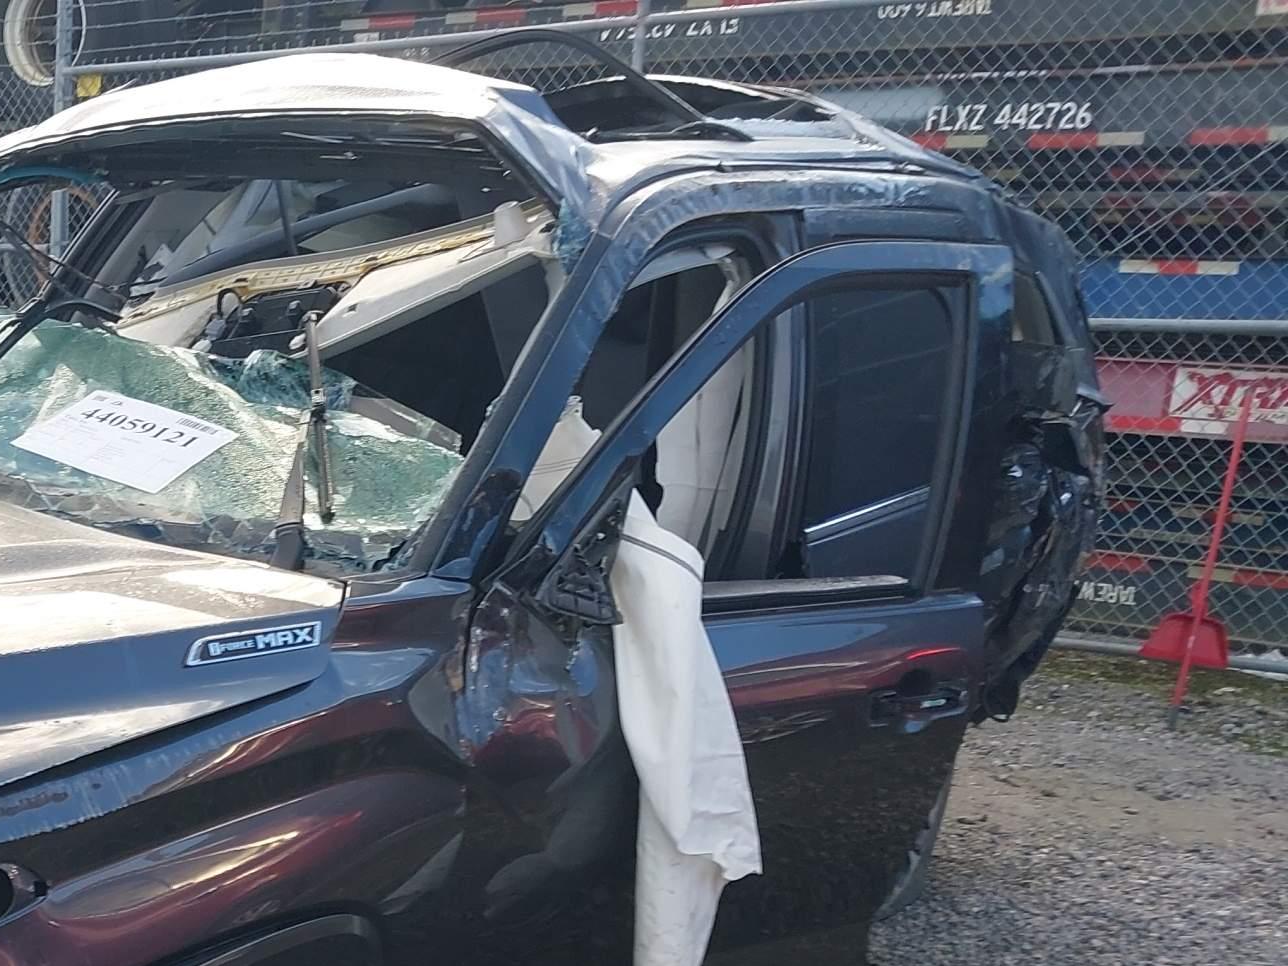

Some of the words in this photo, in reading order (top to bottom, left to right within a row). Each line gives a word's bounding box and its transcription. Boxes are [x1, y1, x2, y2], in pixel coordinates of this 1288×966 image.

[924, 103, 987, 132] FLXZ
[993, 101, 1093, 130] 442726
[81, 408, 198, 448] 44059121
[255, 627, 313, 650] MAX
